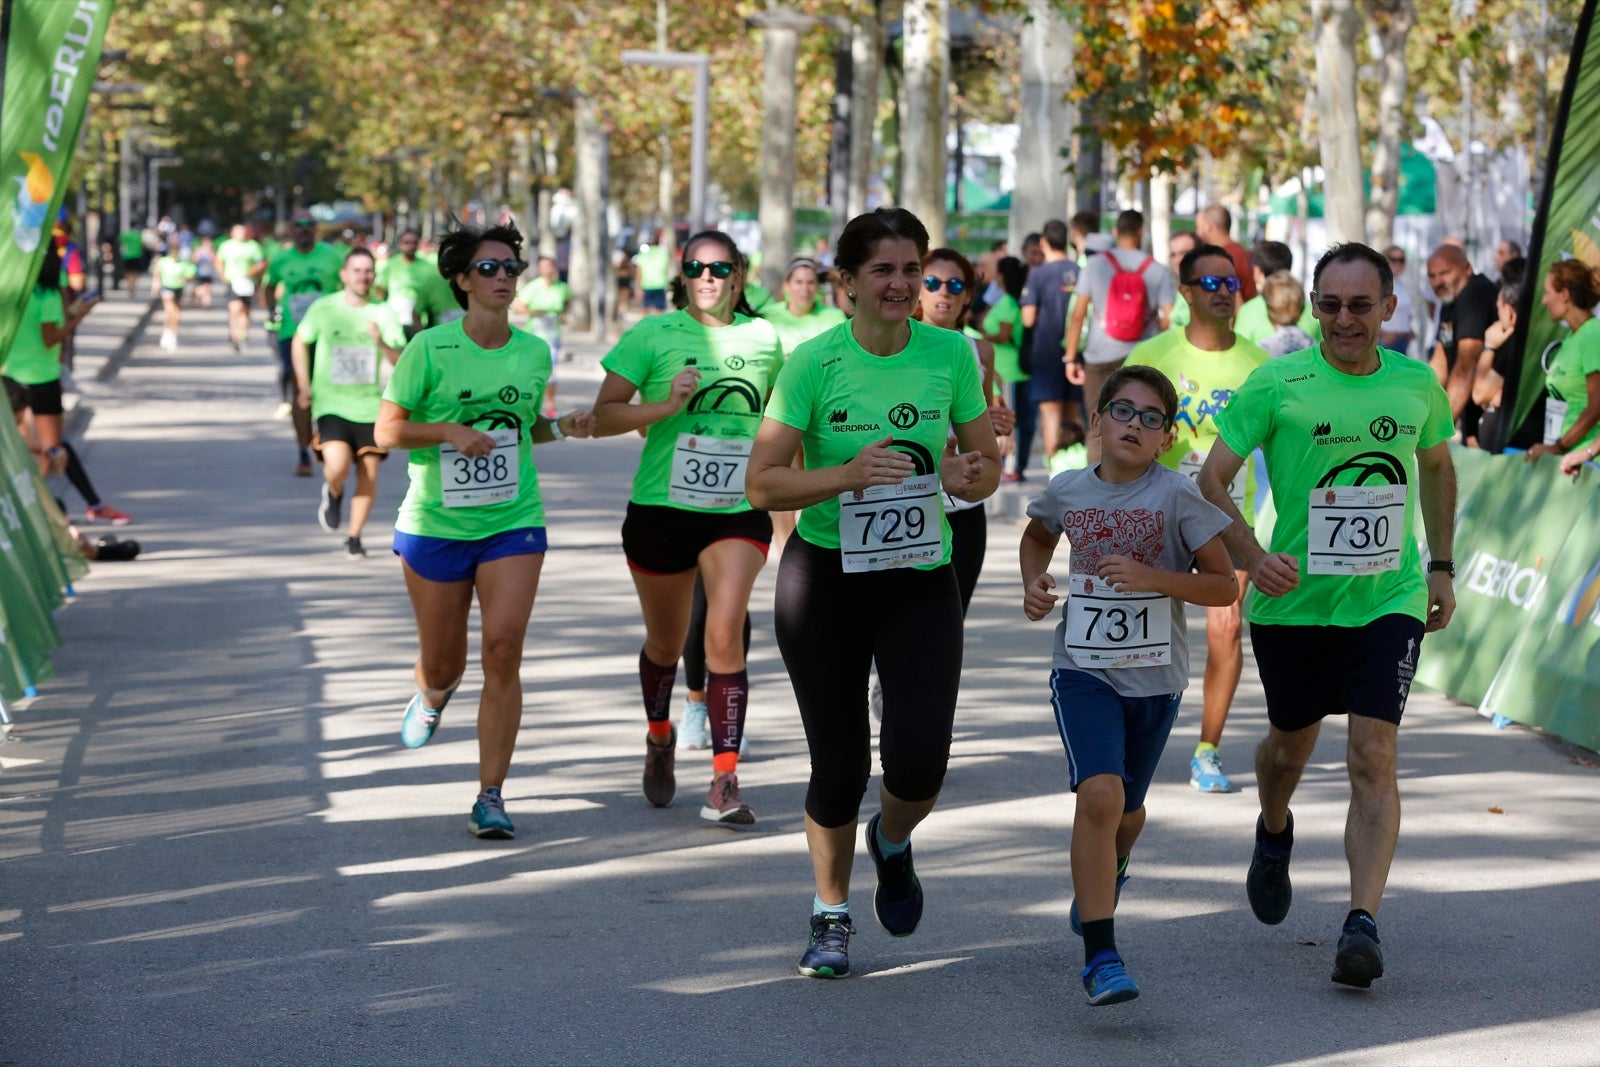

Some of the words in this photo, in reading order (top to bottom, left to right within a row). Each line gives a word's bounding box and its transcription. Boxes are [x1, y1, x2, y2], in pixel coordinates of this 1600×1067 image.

[832, 423, 881, 433] IBERDROLA
[1316, 435, 1361, 446] IBERDROLA
[454, 454, 508, 484] 388
[683, 458, 738, 488] 387
[855, 506, 925, 546] 729
[1324, 515, 1389, 549] 730
[1083, 606, 1149, 642] 731
